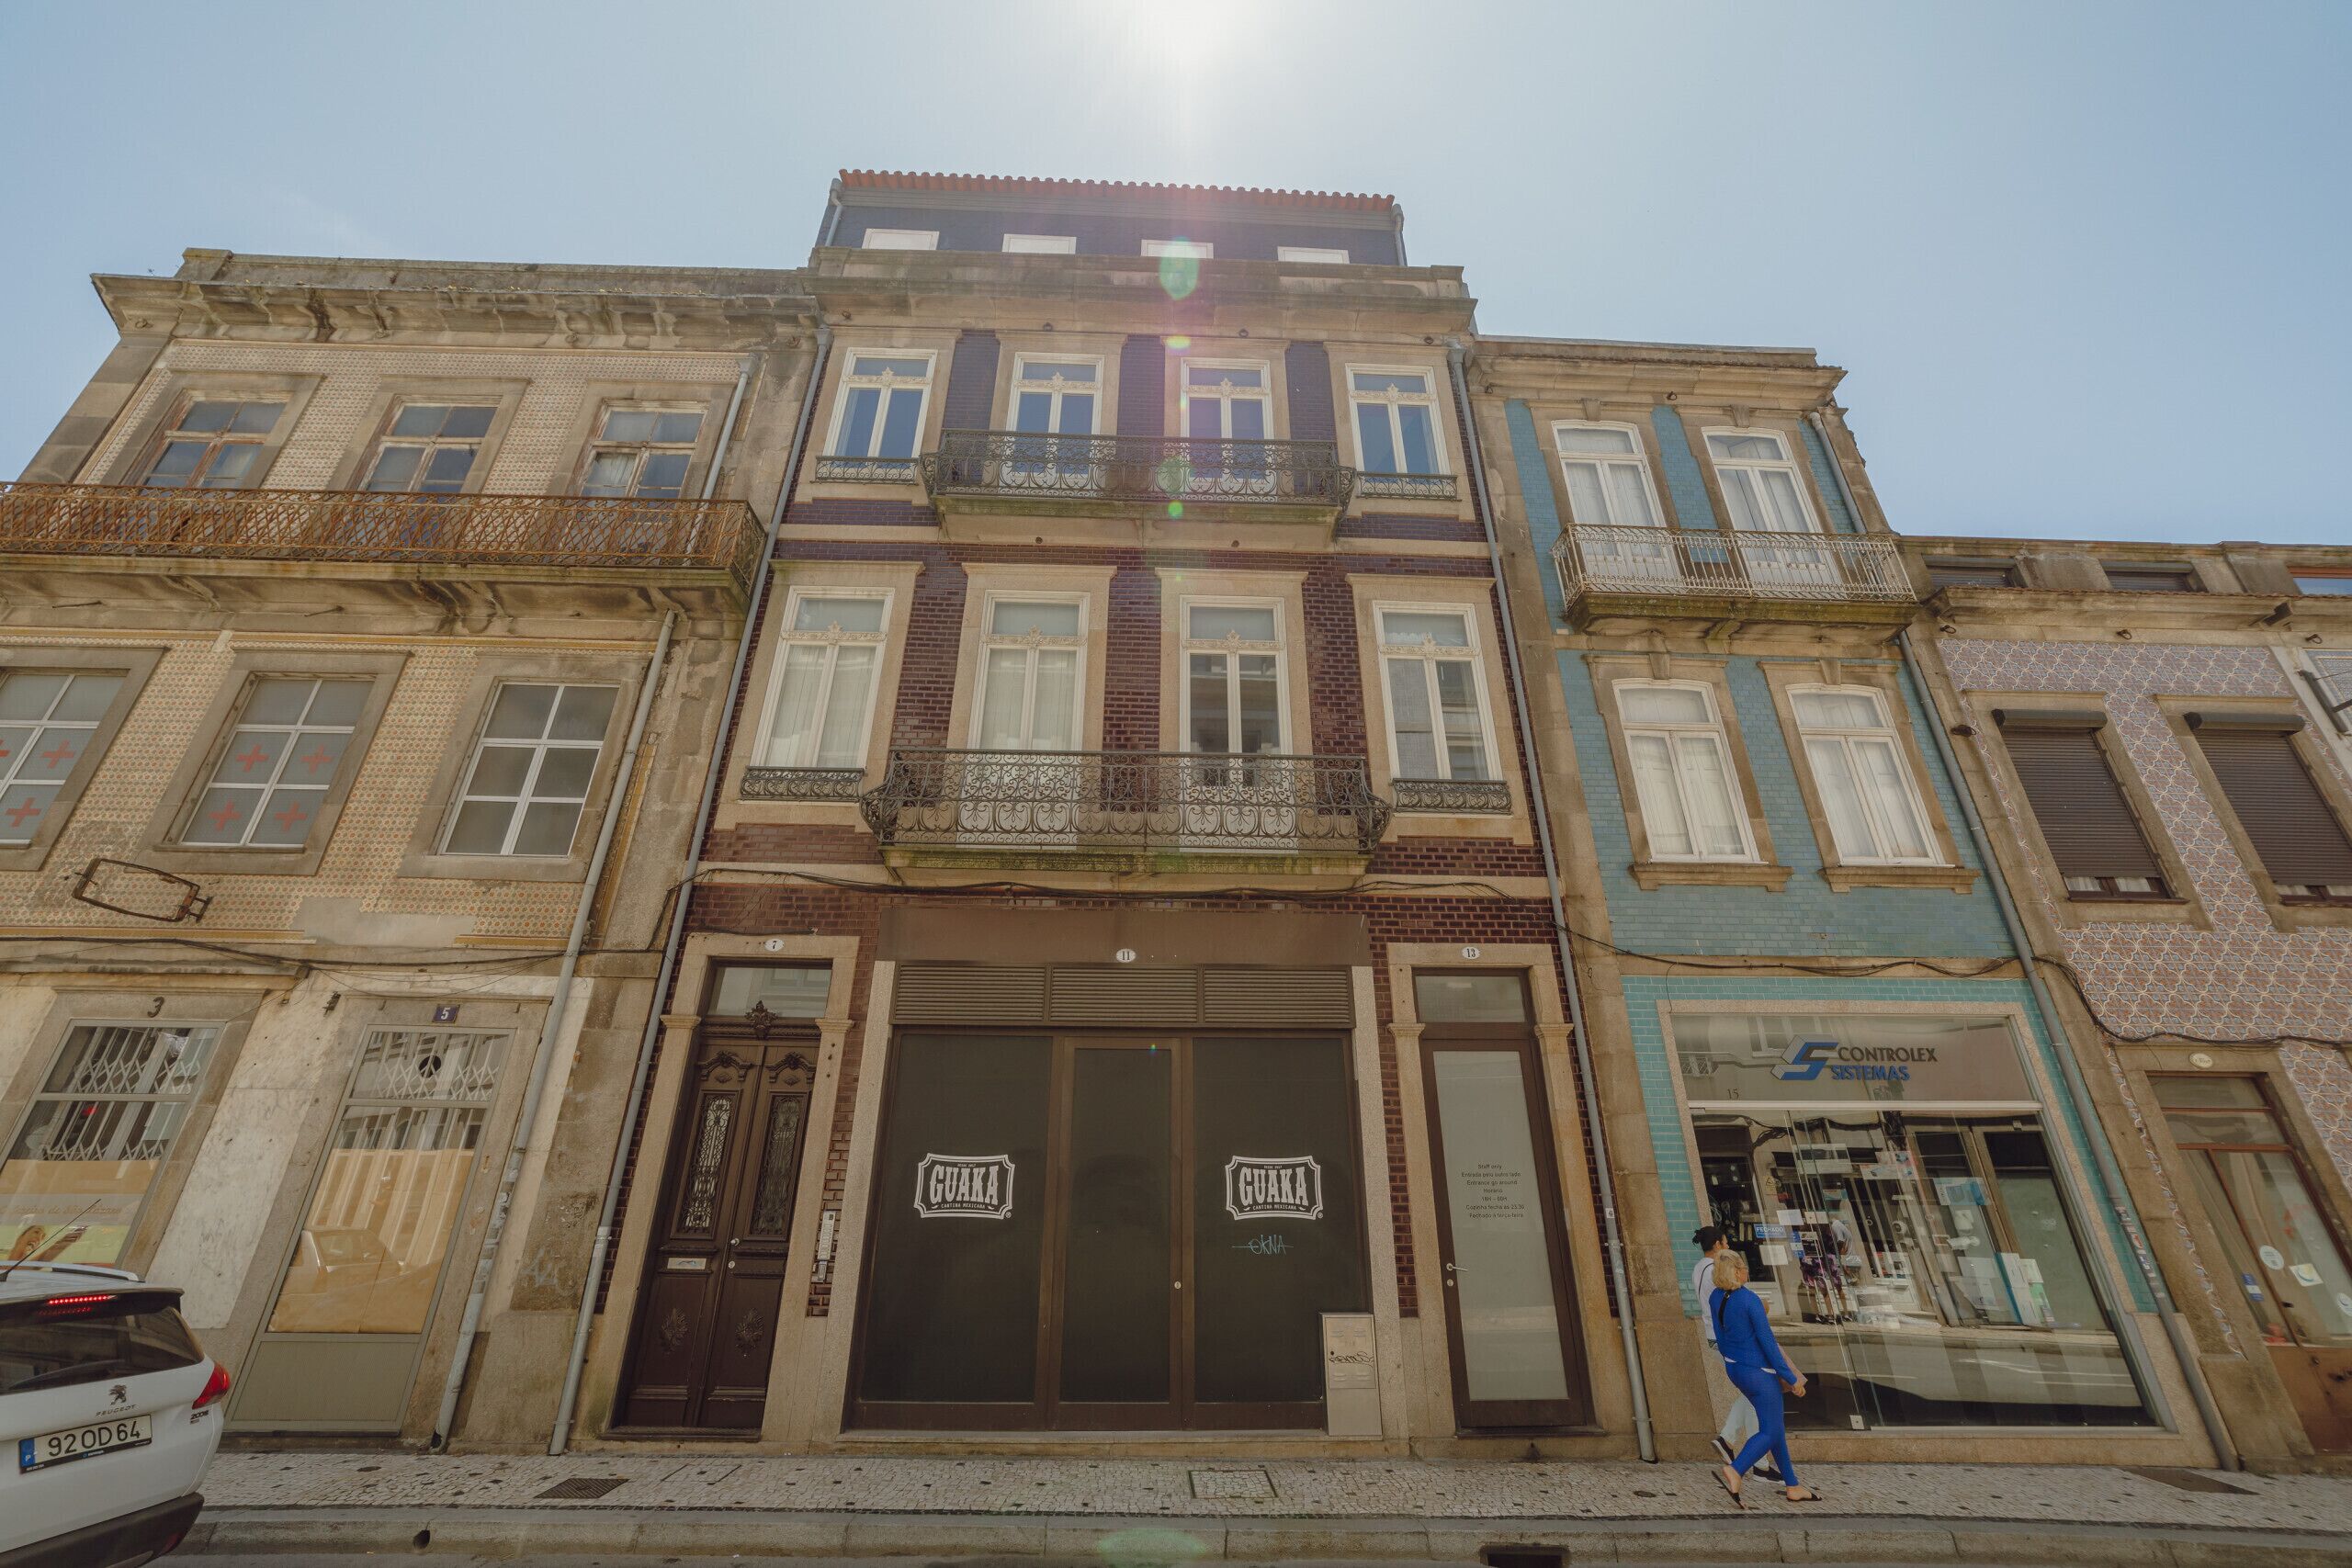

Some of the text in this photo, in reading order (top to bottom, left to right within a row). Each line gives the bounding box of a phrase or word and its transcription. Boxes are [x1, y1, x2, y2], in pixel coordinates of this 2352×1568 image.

[772, 940, 777, 950] 7
[1122, 951, 1130, 961] 11
[1466, 948, 1476, 958] 13
[147, 996, 165, 1018] 3
[440, 1007, 451, 1021] 5
[1837, 1046, 1938, 1063] CONTROLEX
[1830, 1065, 1911, 1081] SISTEMAS
[1727, 1089, 1740, 1100] 15
[929, 1164, 1000, 1205] GUAKA
[1238, 1166, 1309, 1206] GUAKA
[95, 1404, 138, 1416] PEUGEOT
